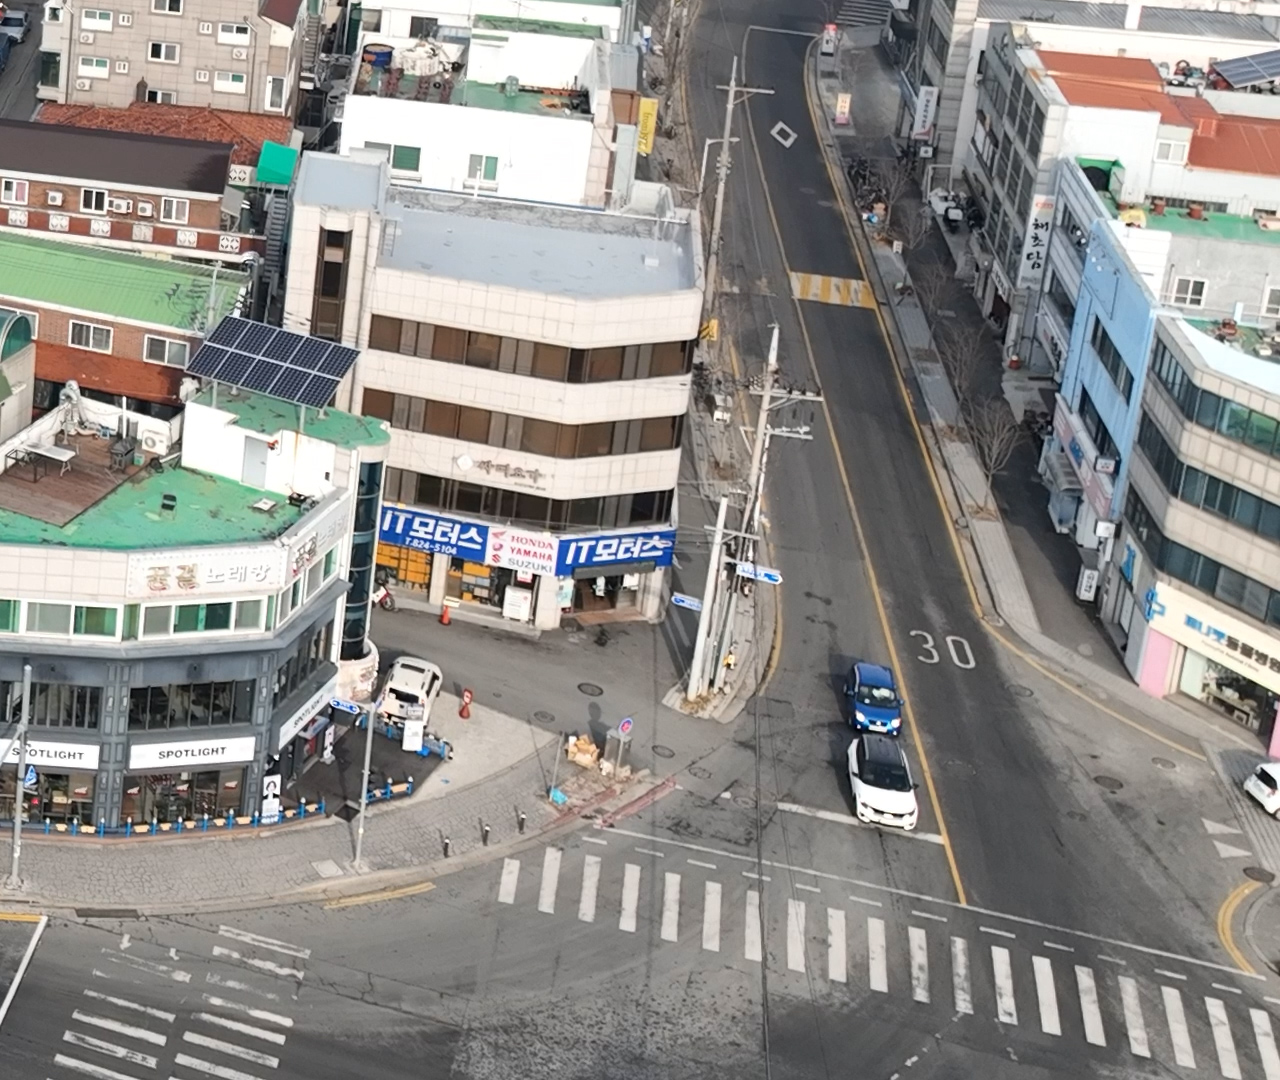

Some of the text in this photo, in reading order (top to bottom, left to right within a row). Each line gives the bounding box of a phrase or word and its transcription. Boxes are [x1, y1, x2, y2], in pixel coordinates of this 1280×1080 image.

[381, 510, 483, 551] IT모터스
[404, 535, 458, 556] T.824-5104
[511, 534, 554, 551] HONDA
[566, 534, 672, 565] IT모터스
[509, 546, 553, 563] YAMAHA
[508, 557, 553, 574] SUZUKI
[909, 629, 977, 671] 30
[158, 747, 227, 760] SPOTLIGHT
